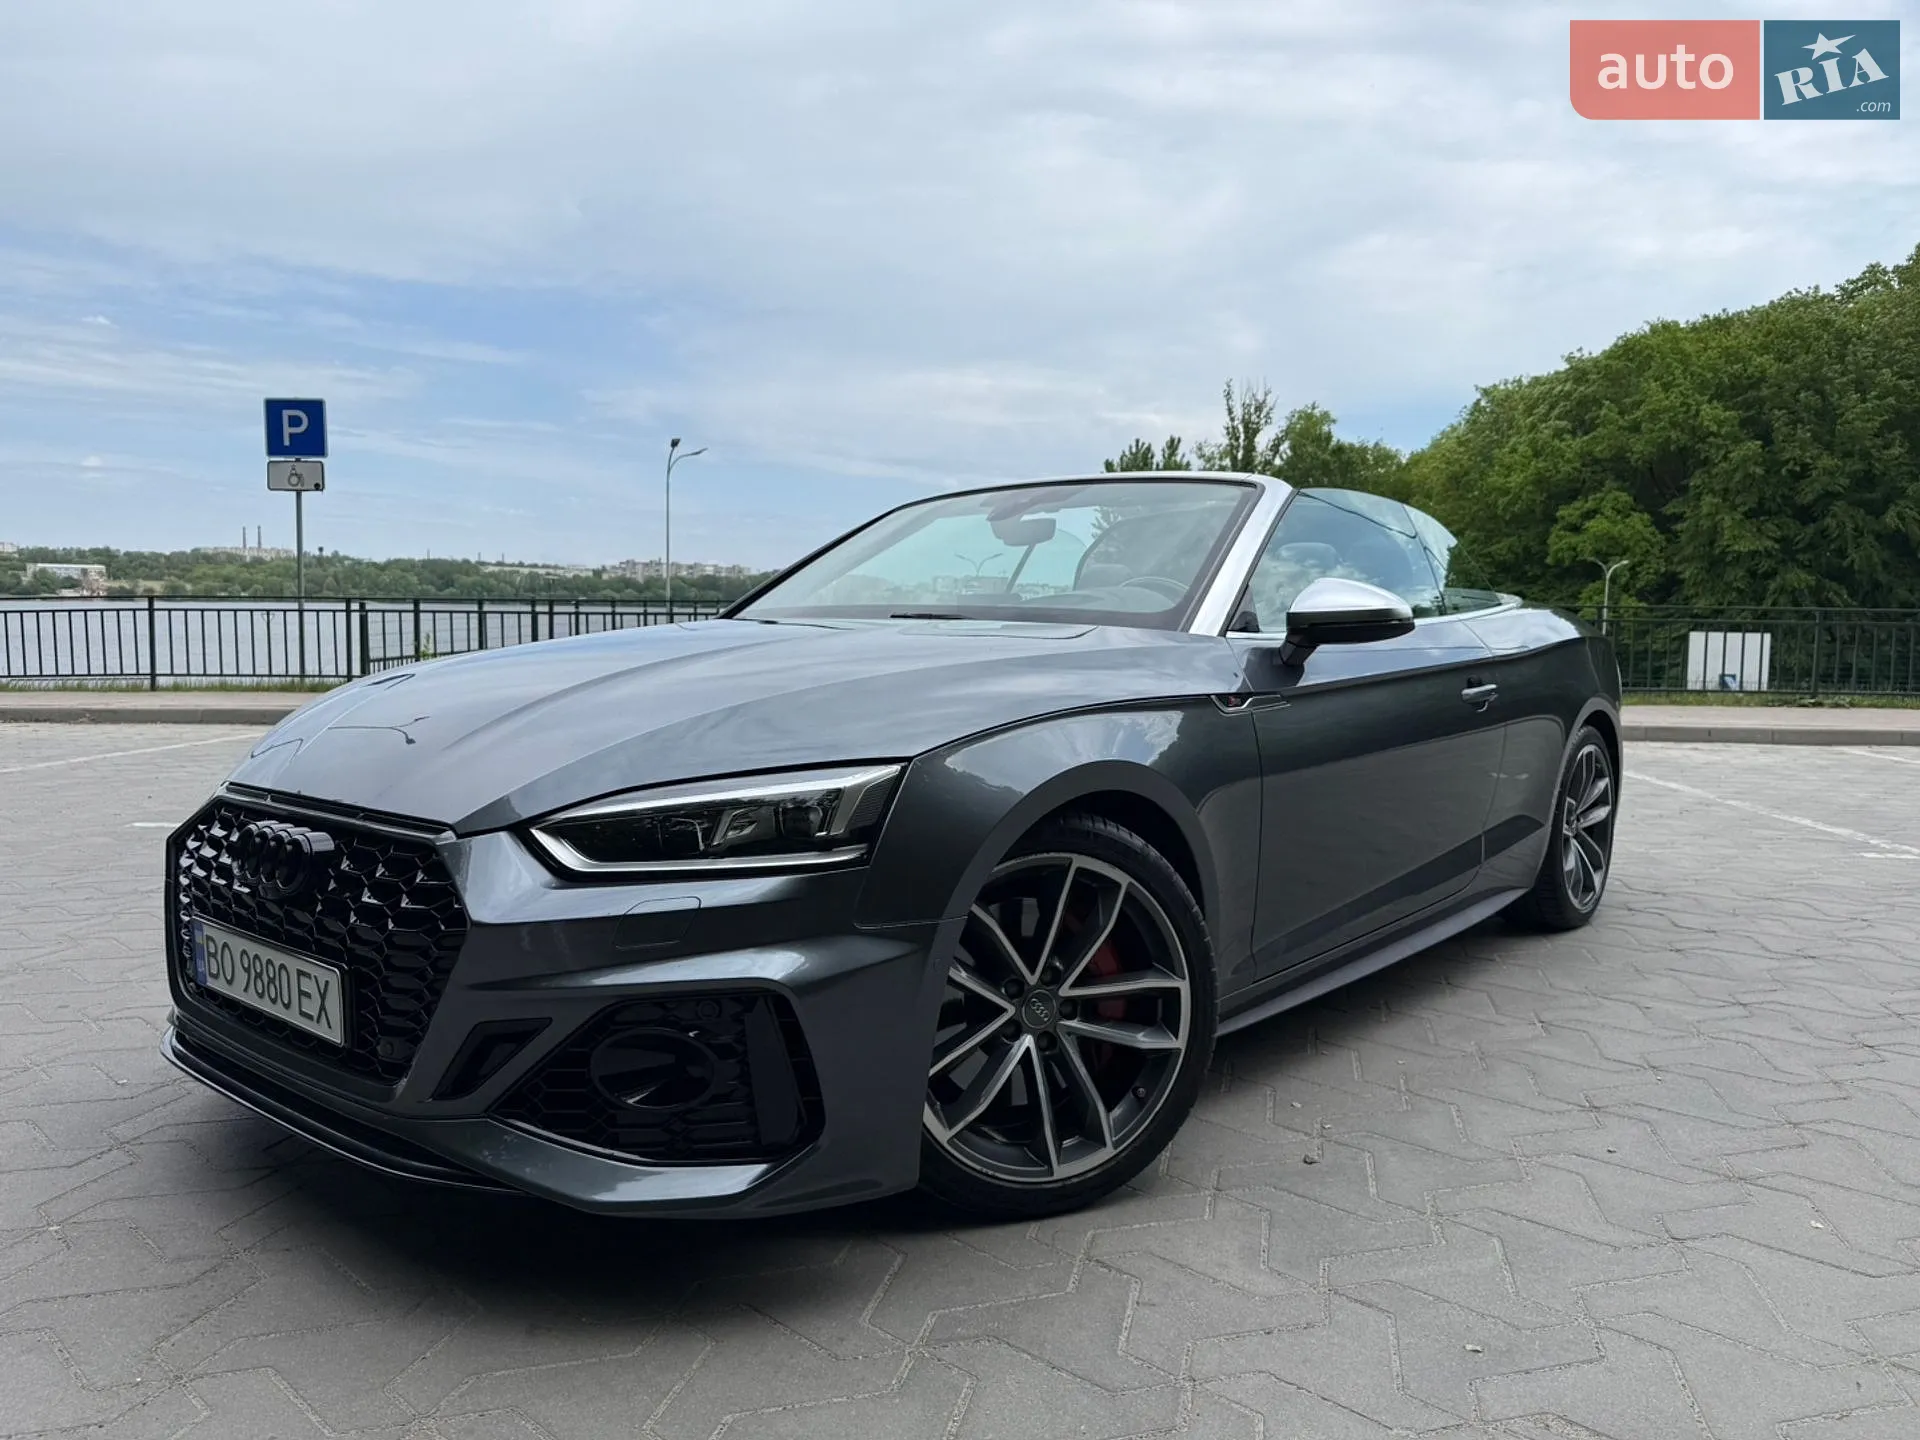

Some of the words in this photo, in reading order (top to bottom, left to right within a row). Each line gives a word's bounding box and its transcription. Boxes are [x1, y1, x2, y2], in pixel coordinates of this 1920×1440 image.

[282, 409, 309, 446] P
[205, 933, 235, 986] BO
[240, 948, 291, 1011] 9880
[296, 967, 332, 1030] EX
